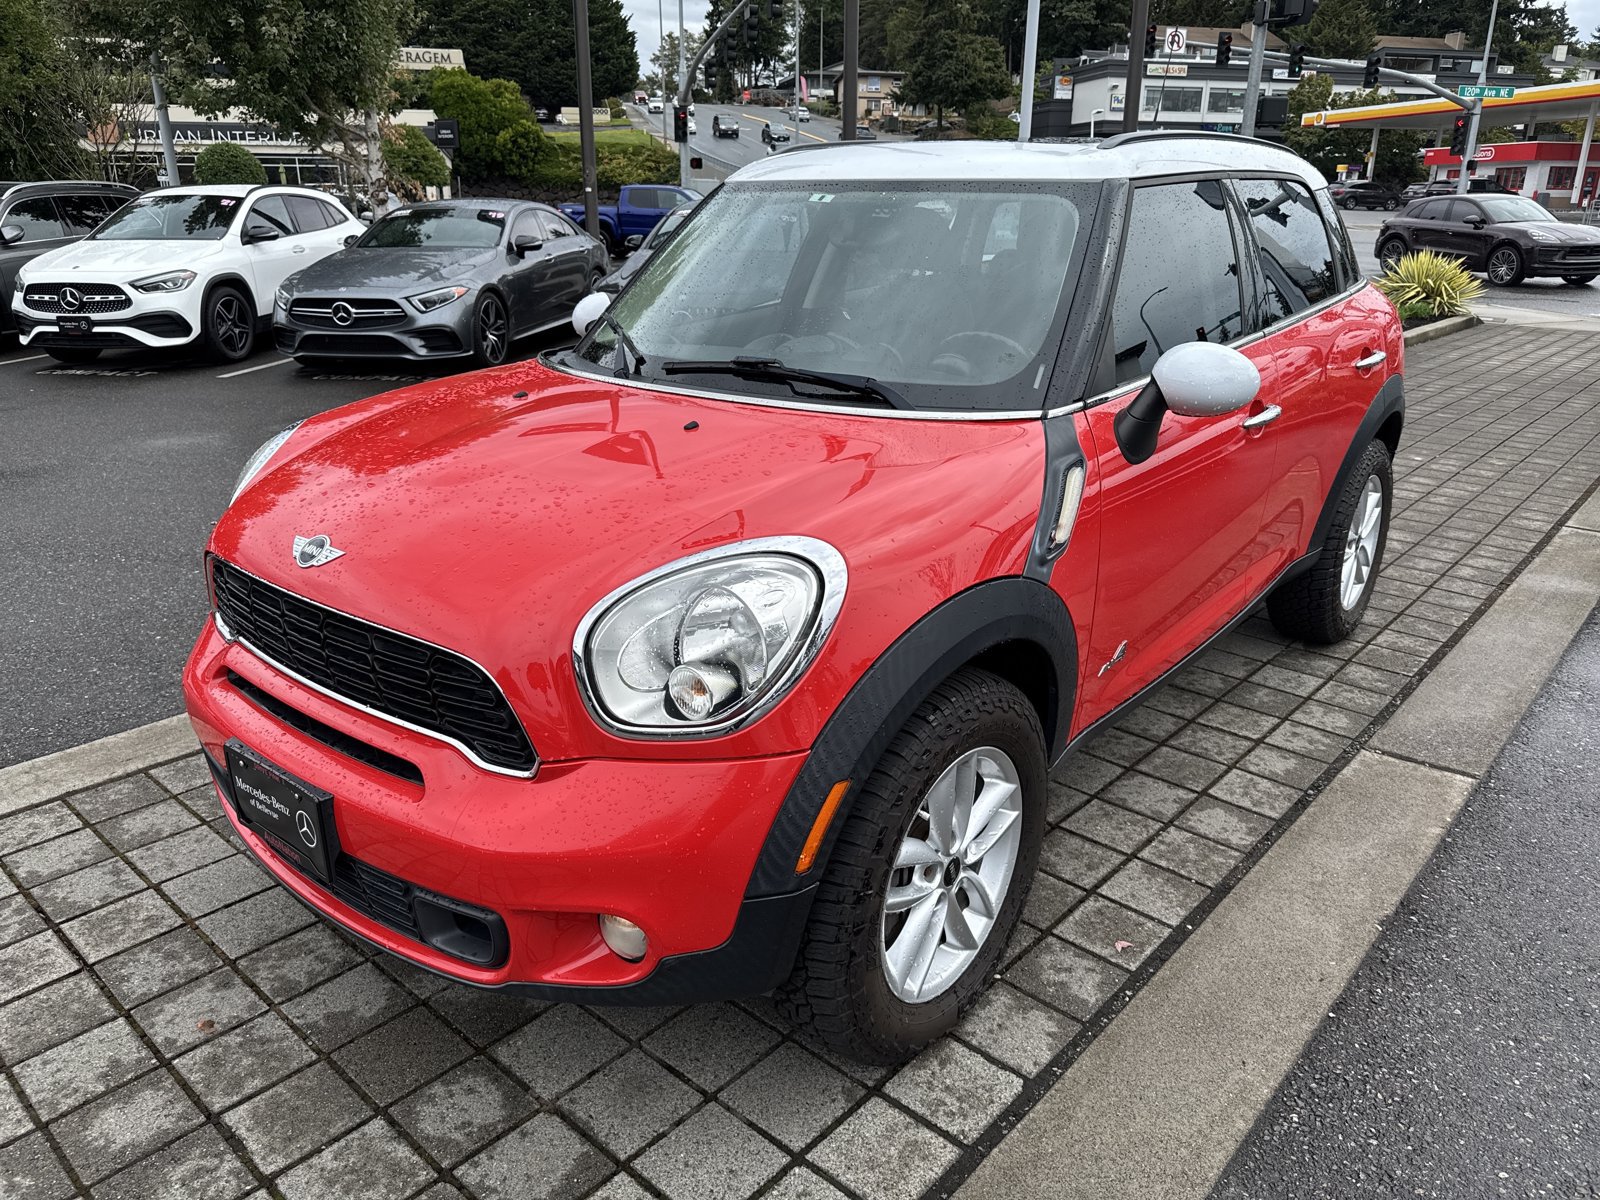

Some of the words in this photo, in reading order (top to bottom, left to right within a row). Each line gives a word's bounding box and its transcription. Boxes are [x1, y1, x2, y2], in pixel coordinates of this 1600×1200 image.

[1464, 87, 1480, 97] 120th
[1483, 88, 1497, 97] Ave
[1499, 89, 1510, 98] NE
[127, 128, 202, 144] URAN
[304, 543, 322, 556] MINI
[235, 776, 291, 817] Mercedes-Benz
[250, 798, 257, 807] of
[256, 800, 280, 820] Bellevue
